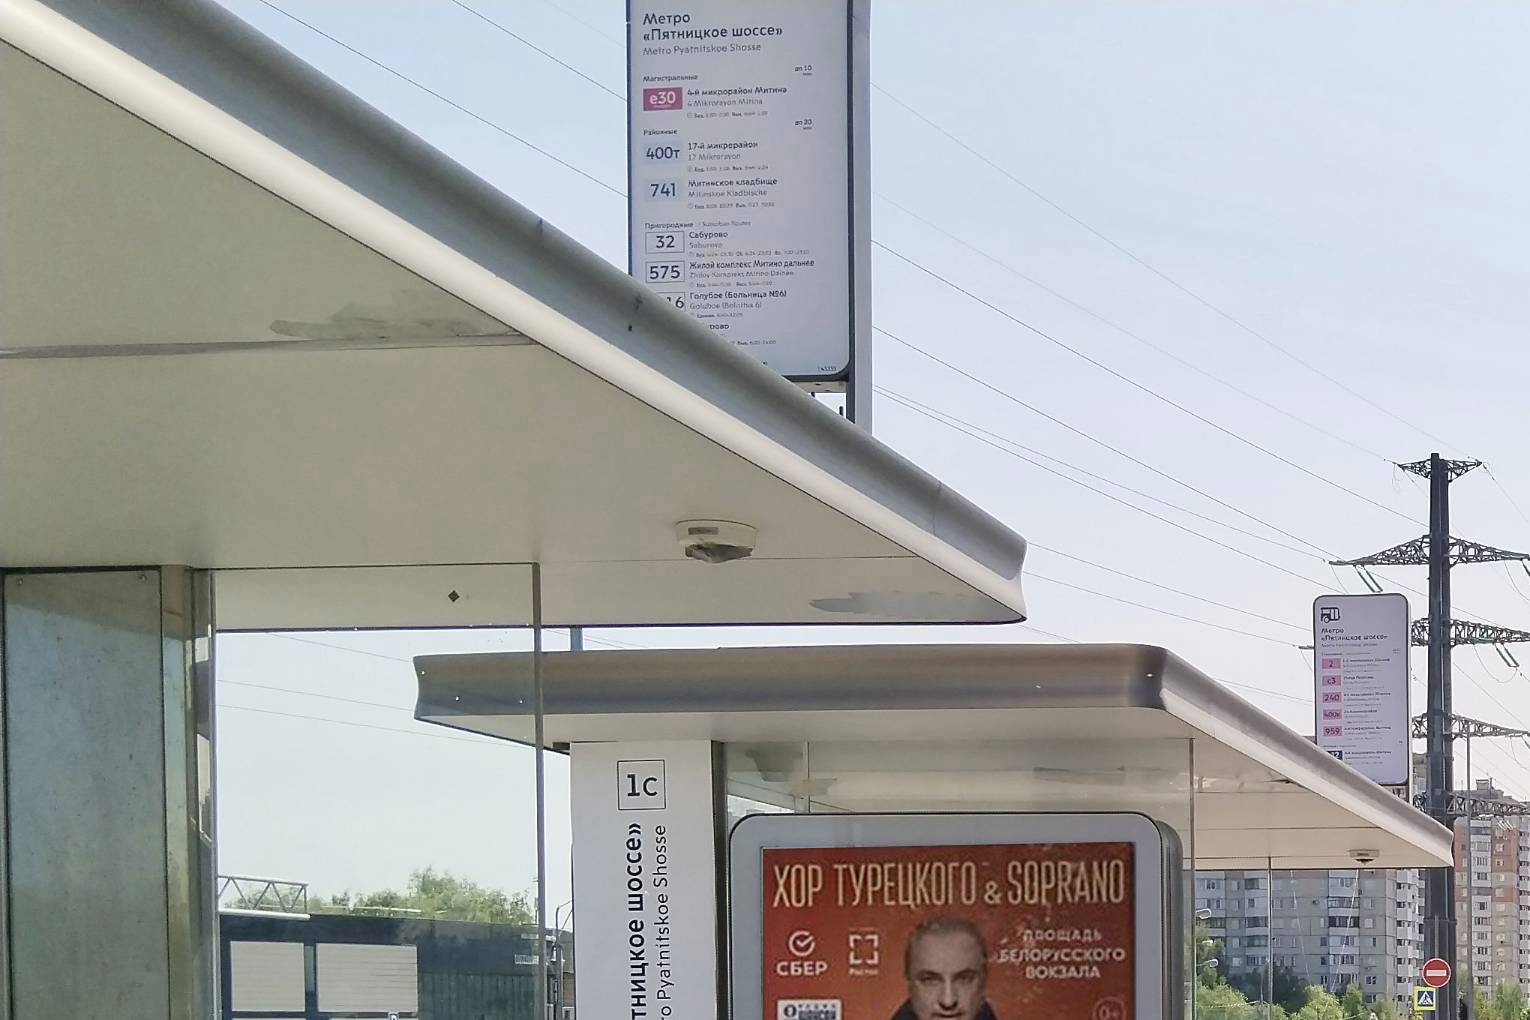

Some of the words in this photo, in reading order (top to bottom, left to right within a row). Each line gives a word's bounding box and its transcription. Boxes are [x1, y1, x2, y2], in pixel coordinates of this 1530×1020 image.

[643, 13, 691, 26] Метро
[643, 27, 728, 41] «Пятницкое
[732, 26, 783, 37] шоссе»
[642, 47, 671, 56] Metro
[646, 146, 681, 160] 400т
[735, 177, 778, 187] кладбище
[650, 183, 677, 198] 741
[655, 235, 675, 249] 32
[689, 231, 729, 240] Сабурово
[649, 265, 681, 280] 575
[1325, 727, 1340, 735] 959
[652, 825, 669, 888] Shosse
[625, 822, 645, 912] шоссе»
[773, 863, 823, 908] ХОР
[833, 860, 977, 909] ТУРЕЦКОГО
[984, 880, 1001, 904] &
[1006, 859, 1125, 905] SOPRANO
[1022, 929, 1102, 943] ПЛОЩАДЬ
[653, 894, 675, 1001] Pyatnitskoe
[998, 947, 1126, 962] БЕЛОРУССКОГО
[776, 961, 828, 976] СБЕР
[1025, 965, 1101, 979] ВОКЗАЛА
[1099, 1005, 1118, 1020] 0+
